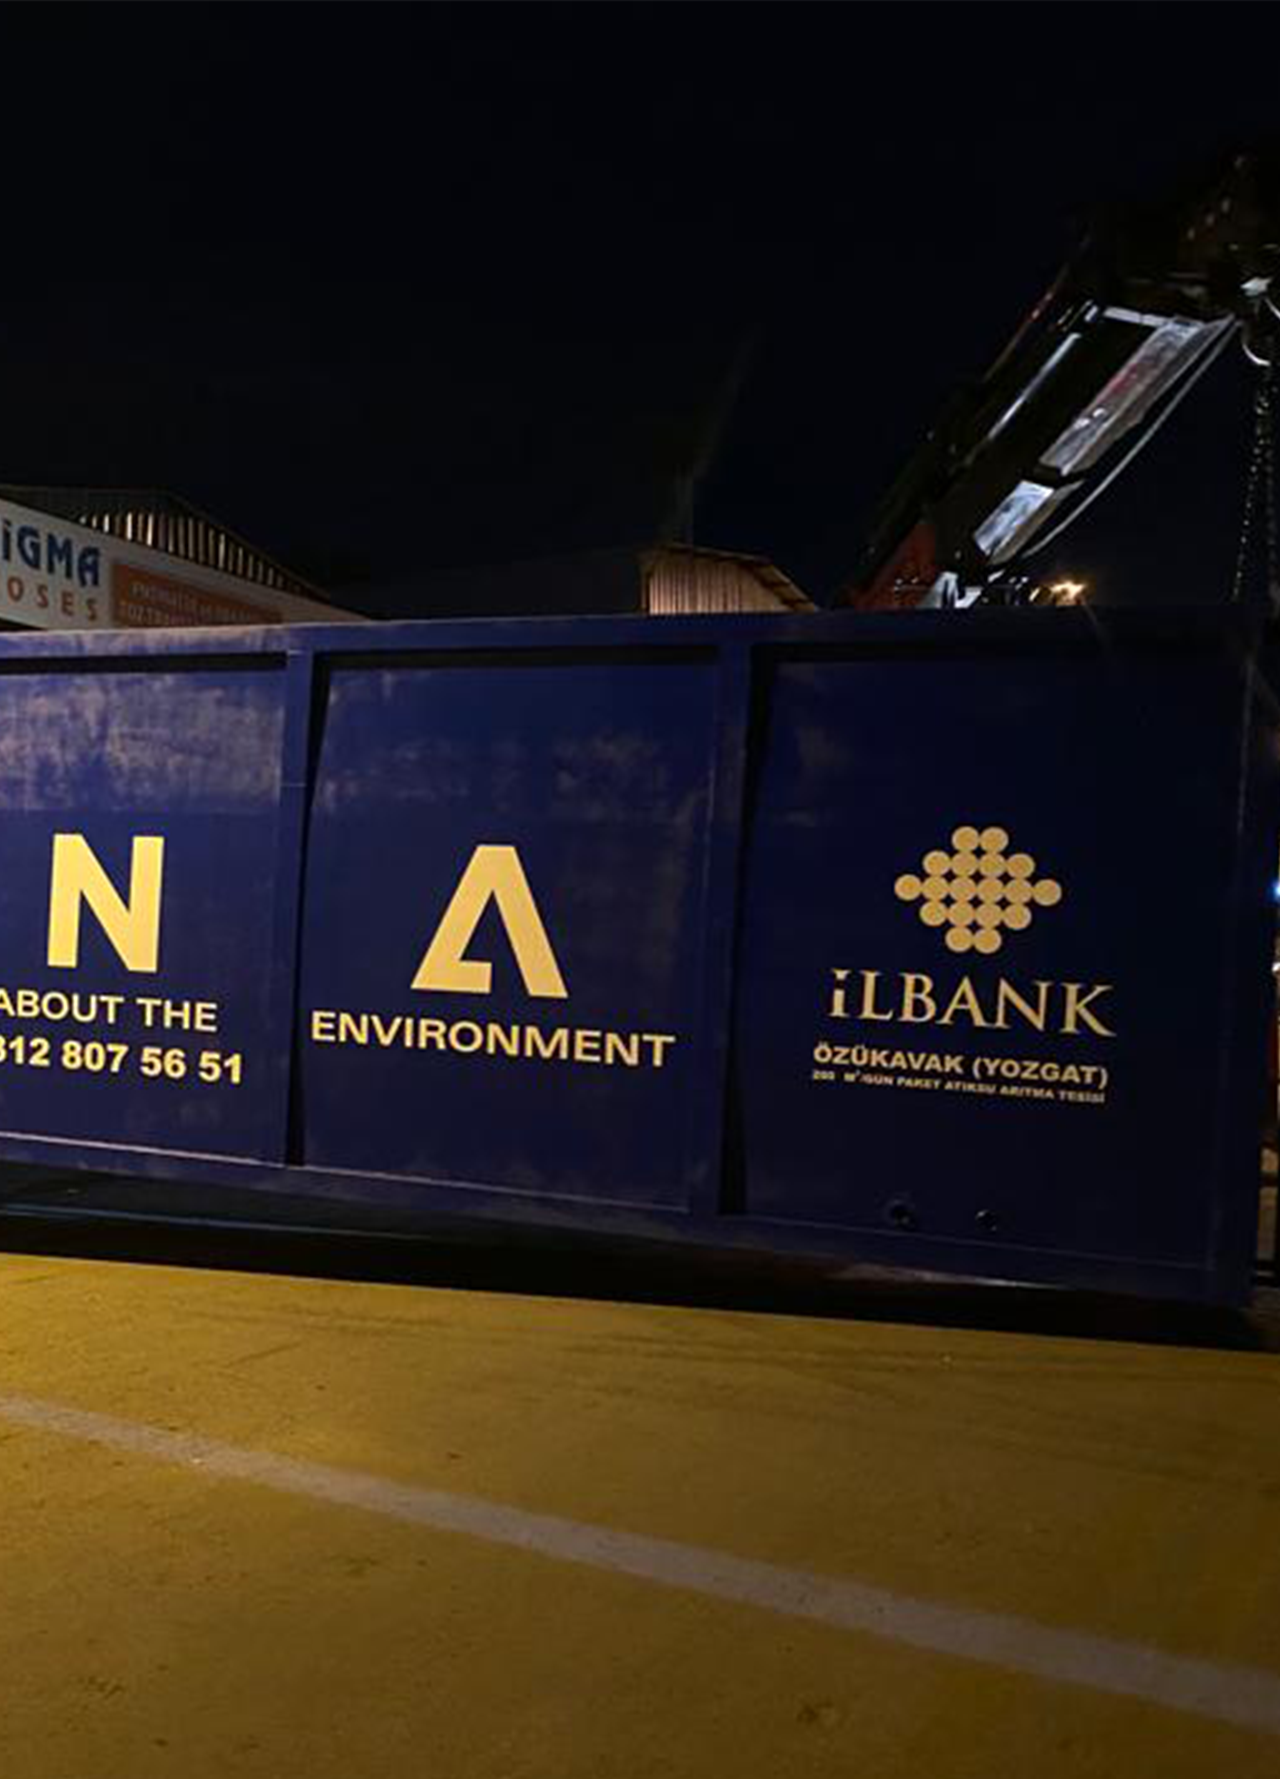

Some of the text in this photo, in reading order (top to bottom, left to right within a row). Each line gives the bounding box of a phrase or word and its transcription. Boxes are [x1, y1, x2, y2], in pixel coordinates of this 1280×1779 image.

[135, 997, 218, 1032] THE
[61, 1040, 129, 1073] 807
[140, 1046, 187, 1079] 56
[199, 1050, 242, 1084] 51
[311, 1010, 676, 1068] ENVIRONMENT
[813, 1041, 1109, 1090] ÖZÜKAVAK (YOZGAT)
